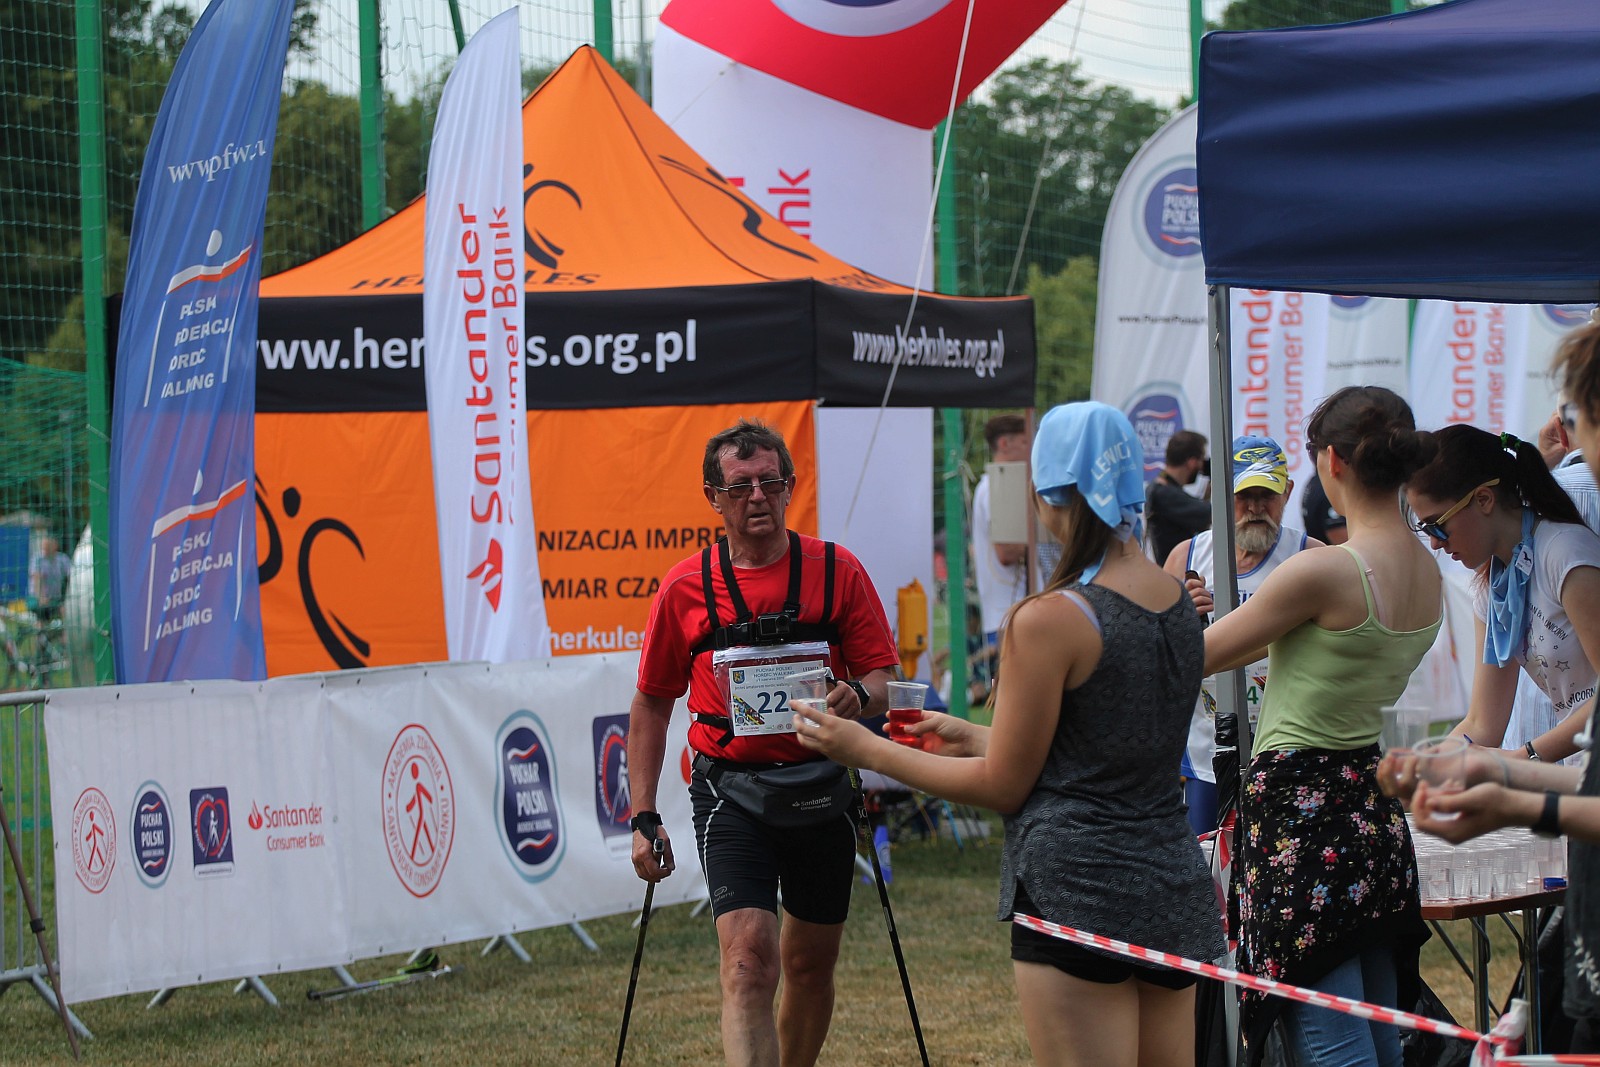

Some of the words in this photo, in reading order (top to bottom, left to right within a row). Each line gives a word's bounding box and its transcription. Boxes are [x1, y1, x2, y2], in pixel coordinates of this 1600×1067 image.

[456, 203, 503, 524] Santander
[1446, 303, 1477, 423] tander
[1284, 332, 1304, 472] Consumer
[538, 529, 637, 552] NIZACJA
[542, 578, 607, 600] MIAR
[616, 577, 659, 599] CZA
[549, 625, 645, 650] herkules
[1544, 619, 1568, 640] UNICORN
[509, 761, 541, 785] PUCHAR
[264, 801, 323, 828] Santander
[515, 790, 550, 817] POLSKI
[140, 811, 163, 829] PUCHAR
[140, 829, 165, 848] POLSKI
[267, 835, 307, 852] Consumer
